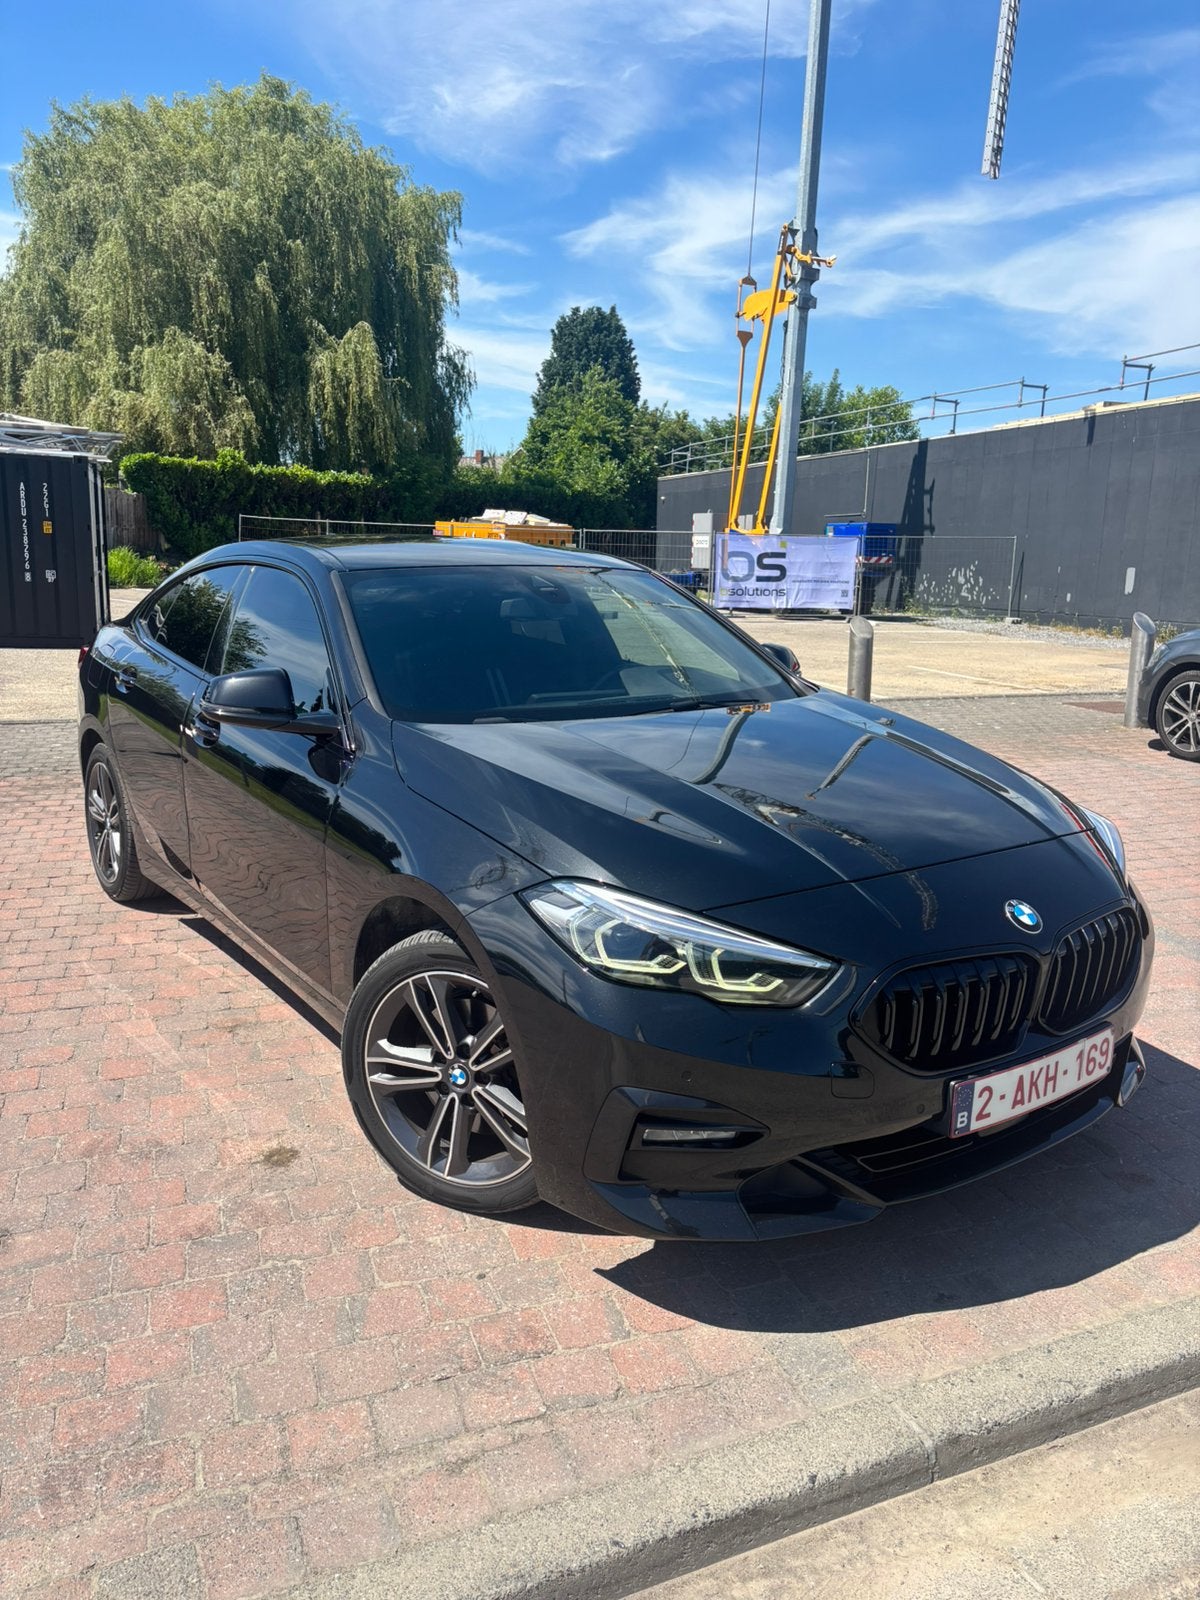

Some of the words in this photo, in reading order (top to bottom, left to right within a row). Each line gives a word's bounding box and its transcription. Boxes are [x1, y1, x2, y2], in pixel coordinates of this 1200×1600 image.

[22, 519, 30, 570] 238296
[25, 571, 31, 582] 8
[956, 1110, 969, 1129] B
[975, 1037, 1111, 1122] 2-AKH-169
